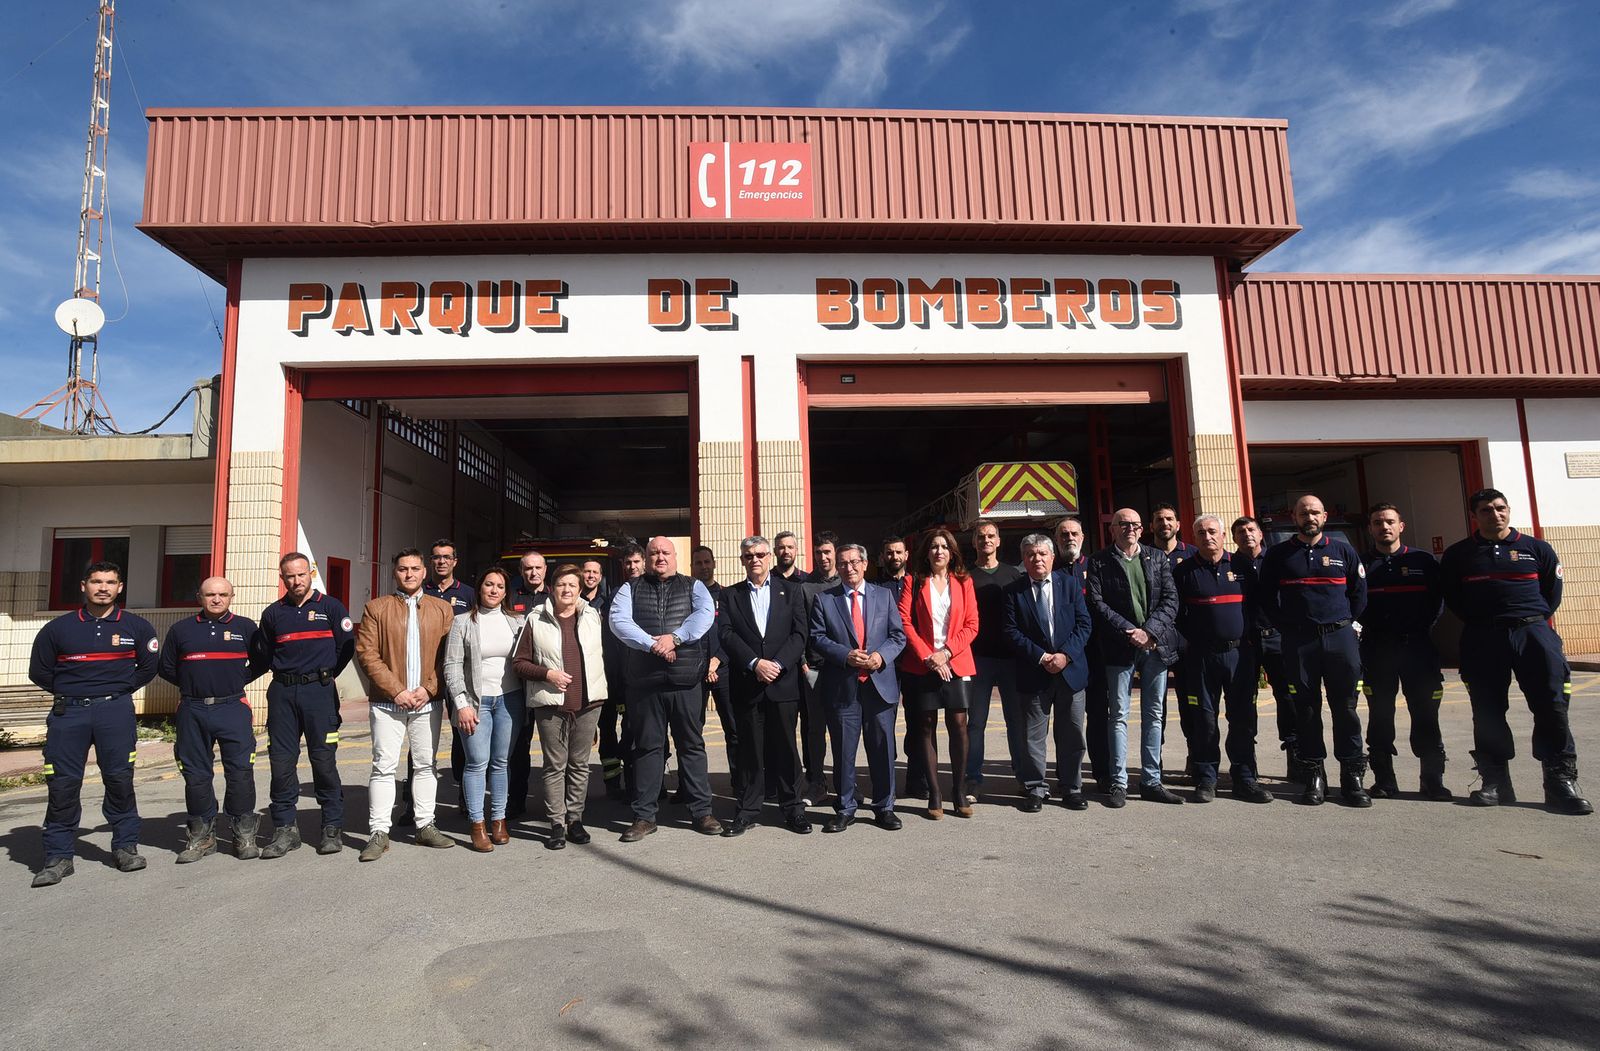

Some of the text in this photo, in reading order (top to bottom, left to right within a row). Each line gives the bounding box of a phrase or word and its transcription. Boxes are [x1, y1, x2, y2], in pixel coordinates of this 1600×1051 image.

[738, 159, 802, 186] 112
[738, 189, 803, 202] Emergencias
[287, 277, 1183, 337] PARQUE DE BOMBEROS
